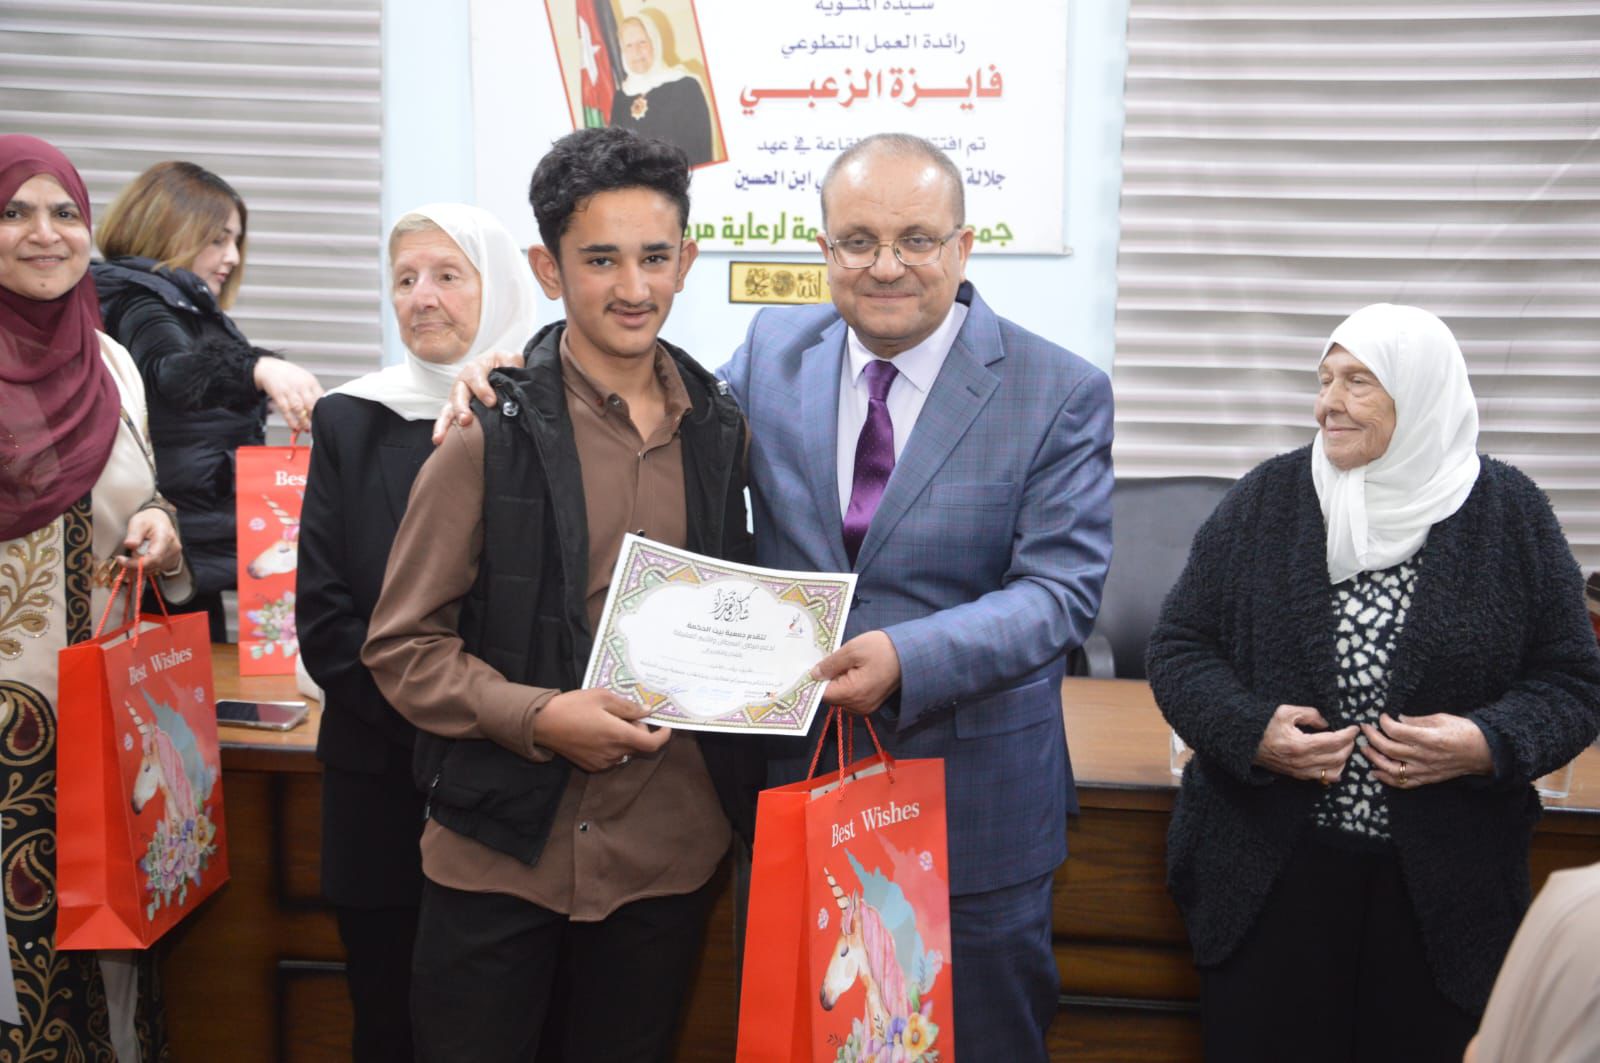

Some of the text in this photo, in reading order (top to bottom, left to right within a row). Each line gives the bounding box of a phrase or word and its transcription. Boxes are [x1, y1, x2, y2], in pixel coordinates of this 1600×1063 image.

[781, 33, 966, 59] رائدة العمل التطوعي
[739, 63, 1004, 116] فايزة الزعبي
[757, 140, 788, 154] عهد
[794, 136, 811, 155] في
[967, 136, 986, 157] تم
[735, 169, 785, 191] الحسين
[788, 169, 811, 191] ابن
[966, 167, 1006, 190] جلالة
[721, 211, 786, 246] لرعاية
[275, 470, 306, 487] Bes
[128, 647, 193, 686] Best Wishes
[831, 800, 920, 848] Best Wishes
